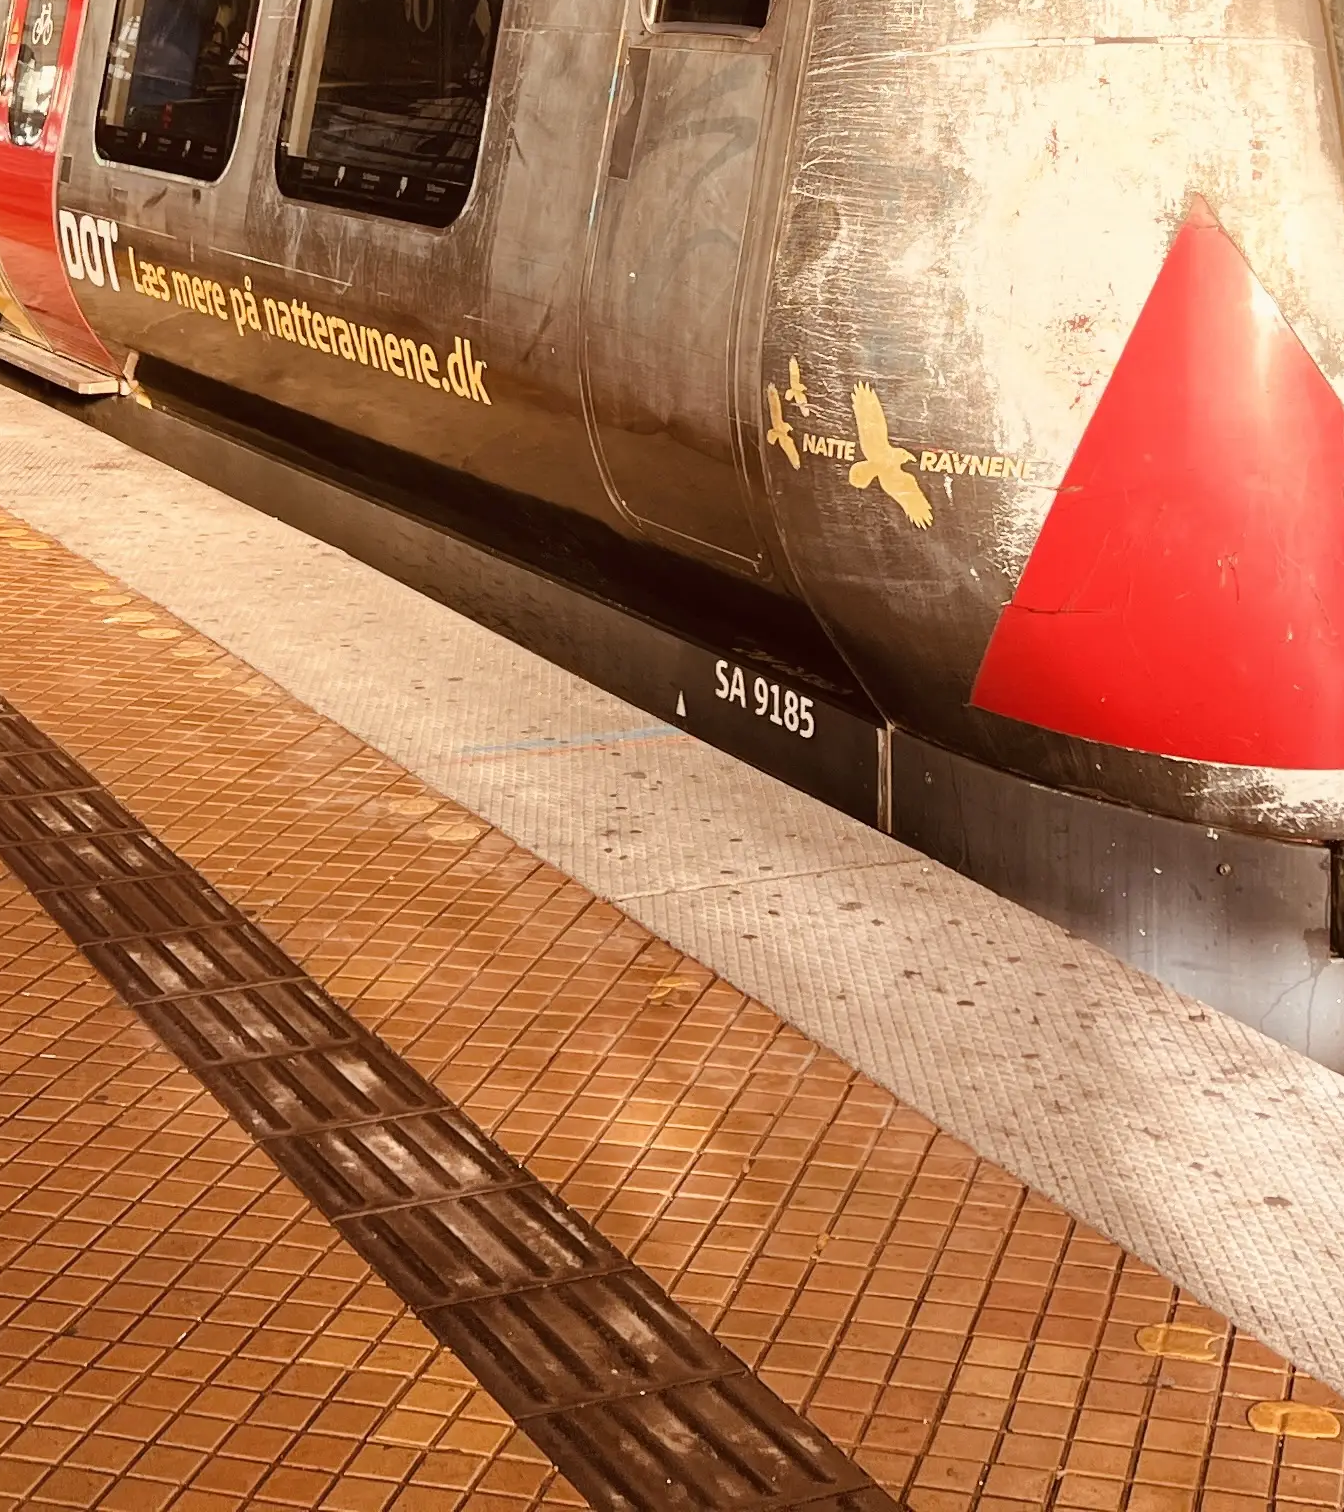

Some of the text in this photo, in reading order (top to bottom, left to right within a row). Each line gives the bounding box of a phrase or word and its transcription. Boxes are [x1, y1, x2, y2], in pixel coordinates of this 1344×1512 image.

[60, 210, 121, 292] DOT
[128, 246, 492, 406] Læs mere på natteravnene.dk
[803, 433, 1037, 479] NATTE RAVNENE
[715, 660, 814, 739] SA 9185
